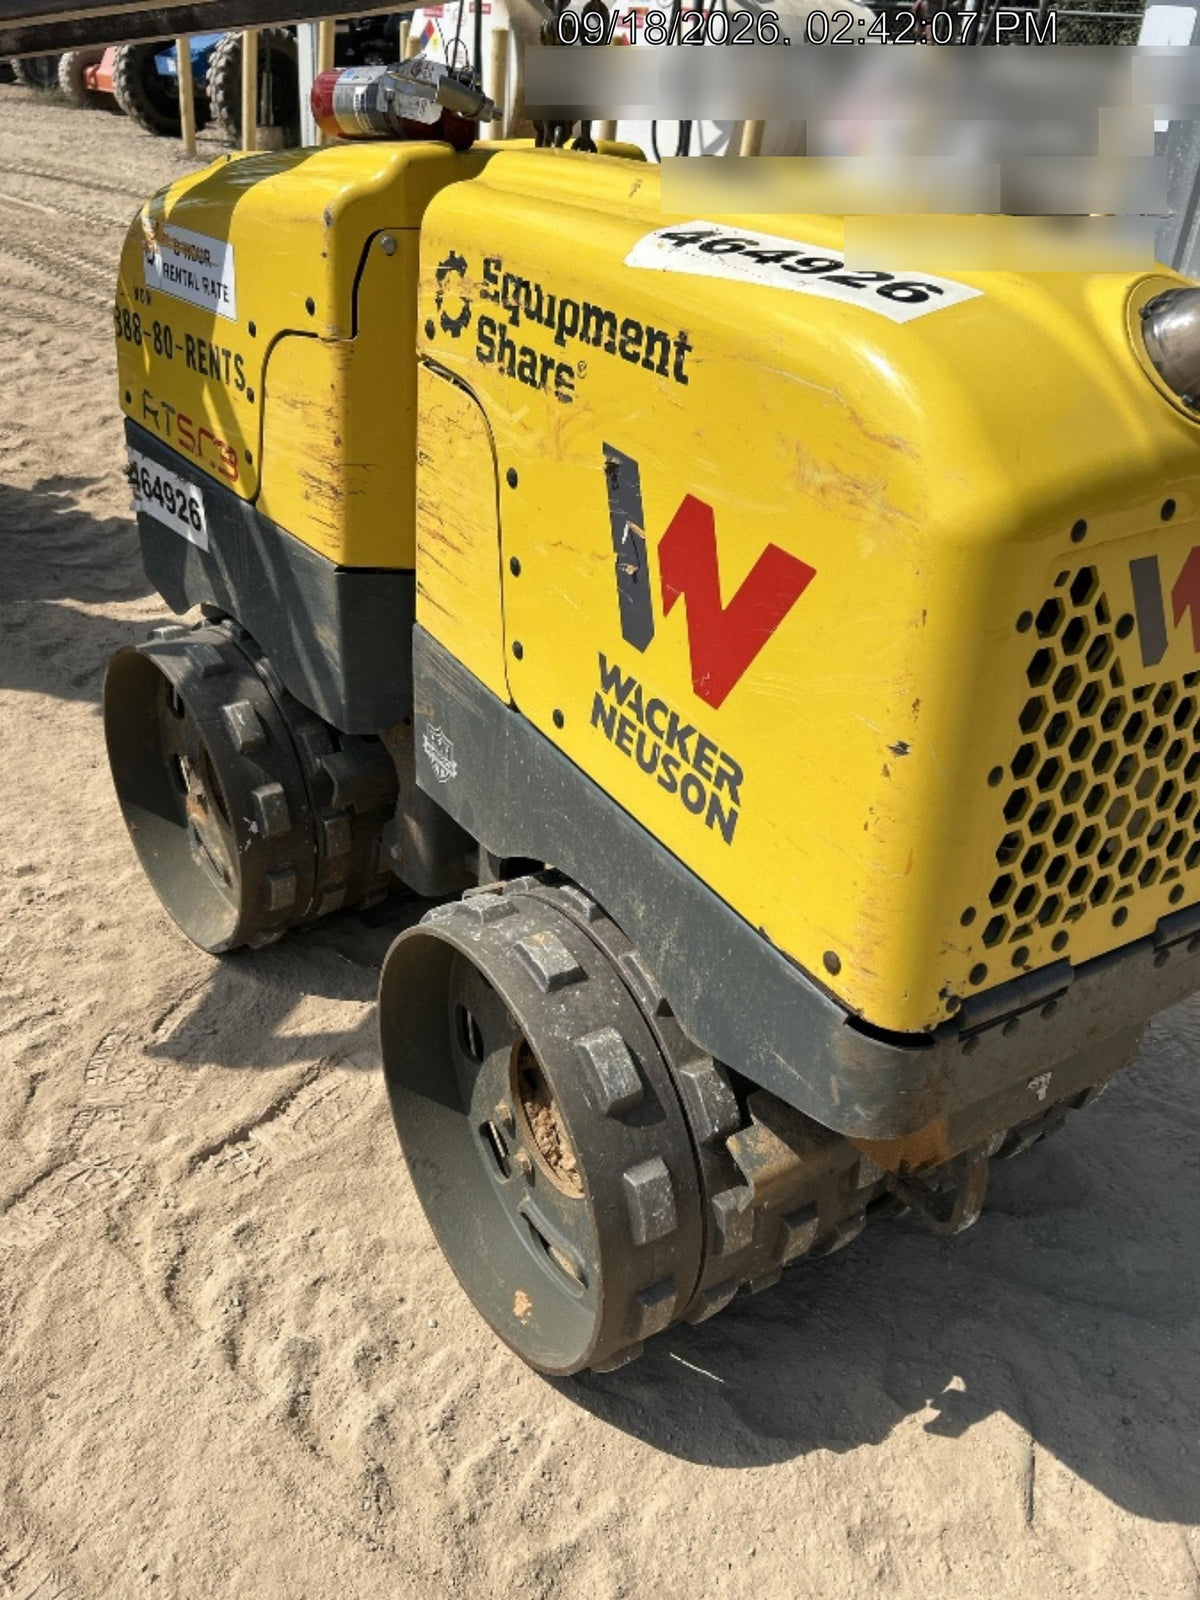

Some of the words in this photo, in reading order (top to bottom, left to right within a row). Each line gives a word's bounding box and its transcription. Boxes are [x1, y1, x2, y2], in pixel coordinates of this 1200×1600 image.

[162, 262, 200, 291] RENTAL
[202, 277, 229, 302] RATE
[659, 229, 944, 304] 464926
[480, 256, 693, 386] Equipment
[126, 460, 202, 532] 464926
[591, 691, 740, 846] NEUSON
[598, 651, 745, 807] WACKER
